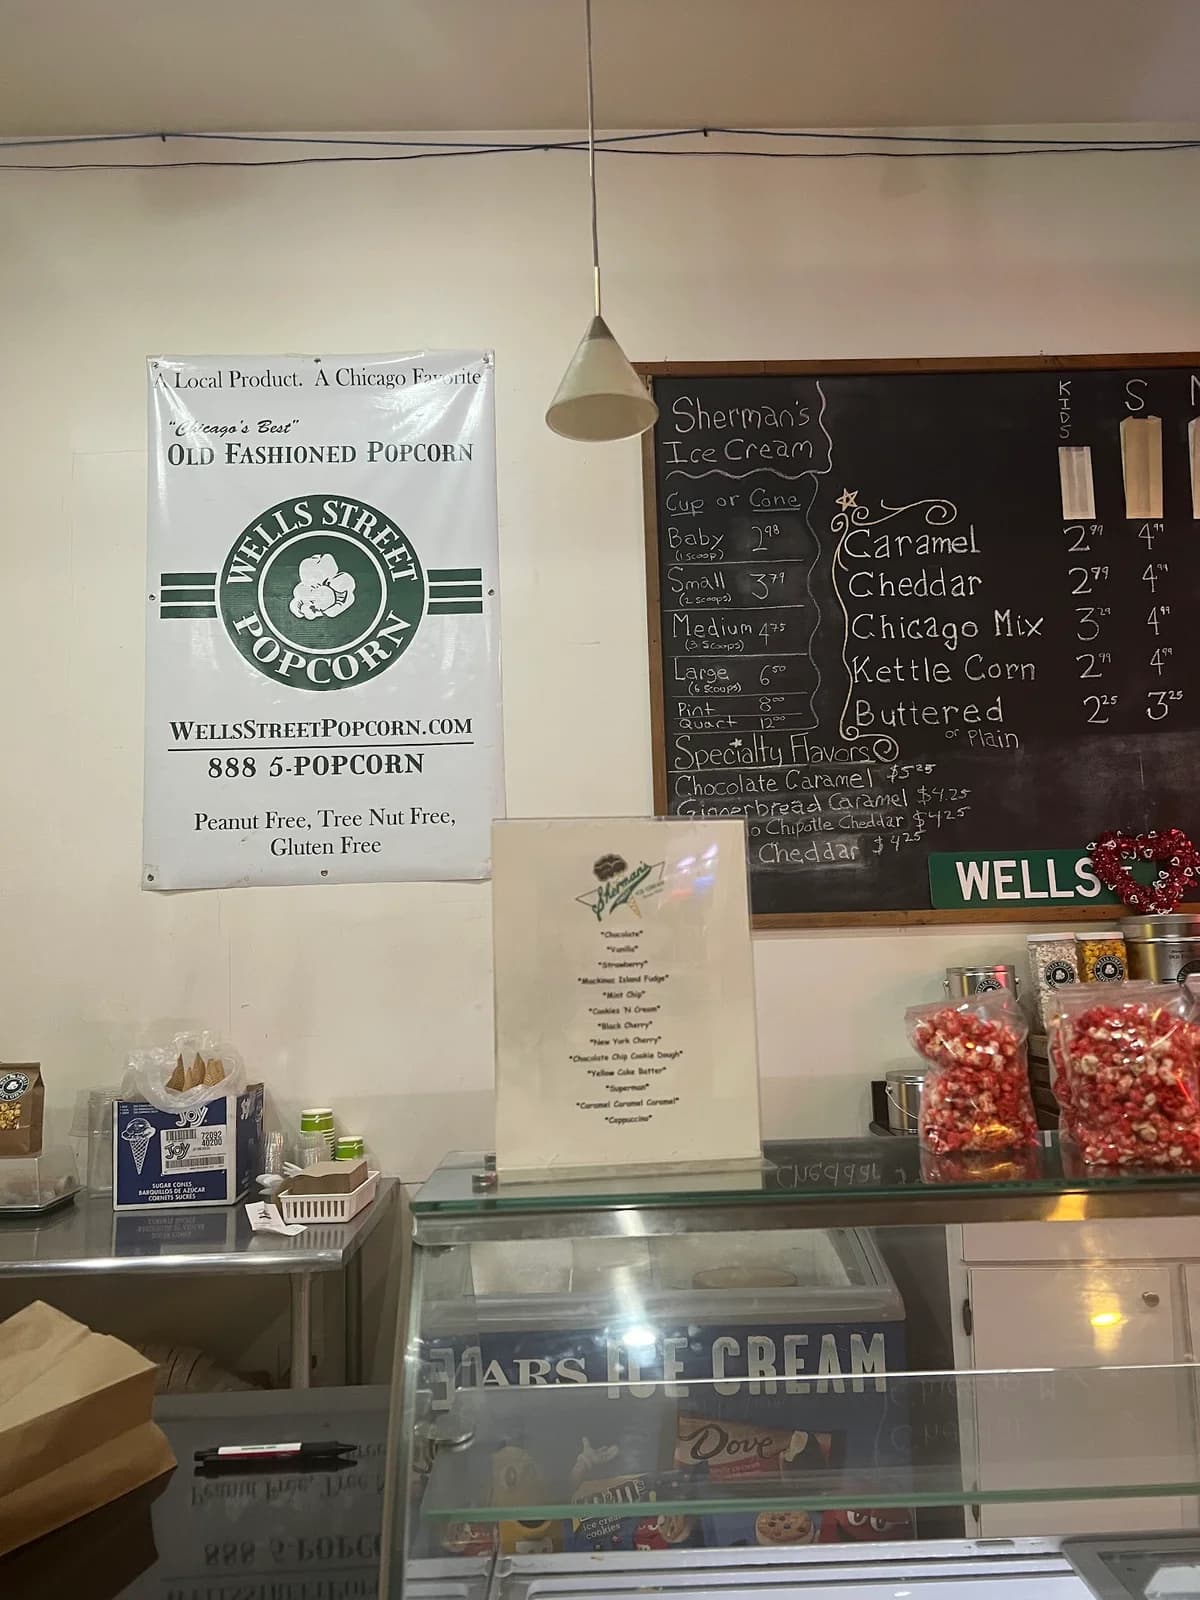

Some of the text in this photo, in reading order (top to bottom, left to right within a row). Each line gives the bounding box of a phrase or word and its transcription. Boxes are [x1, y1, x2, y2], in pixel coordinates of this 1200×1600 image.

[155, 367, 482, 389] A Local Product. A Chicago Favorite
[1124, 378, 1148, 411] S
[672, 396, 810, 433] Sherman's
[1058, 380, 1072, 439] KIDS
[257, 418, 300, 435] Best"
[167, 441, 473, 466] OLD FASHIONED POPCORN
[662, 438, 813, 464] Ice Cream
[666, 487, 801, 517] Cup or Cone
[226, 500, 418, 585] WELLS STREET
[667, 527, 725, 550] Baby
[844, 524, 981, 559] Caramel
[668, 566, 725, 593] Small
[849, 568, 983, 597] Cheddar
[673, 613, 752, 638] Medium
[852, 613, 978, 651] Chicago
[994, 608, 1044, 637] Mix
[232, 610, 412, 684] POPCORN
[674, 657, 730, 684] Large
[852, 655, 953, 683] Kettle
[964, 653, 1036, 681] Corn
[678, 702, 715, 716] Pint
[679, 715, 737, 729] Quart
[855, 696, 1003, 726] Buttered
[674, 732, 871, 770] Specialty Flavors
[945, 729, 1019, 749] or Plain
[208, 753, 425, 778] 888 5-POPCORN
[675, 774, 779, 797] Chocolate
[785, 768, 874, 789] Caramel
[828, 788, 908, 811] Caramel
[194, 807, 456, 831] Peanut Free, Tree Nut Free,
[766, 815, 834, 838] Chipotle
[839, 814, 905, 831] Cheddar
[271, 836, 382, 857] Gluten Free
[759, 840, 860, 863] Cheddar
[955, 857, 1101, 900] WELLS
[611, 1053, 628, 1061] Chip
[483, 1357, 588, 1387] ARS
[607, 1337, 690, 1399] ICE
[711, 1333, 888, 1395] CREAM
[586, 1523, 621, 1539] cookies
